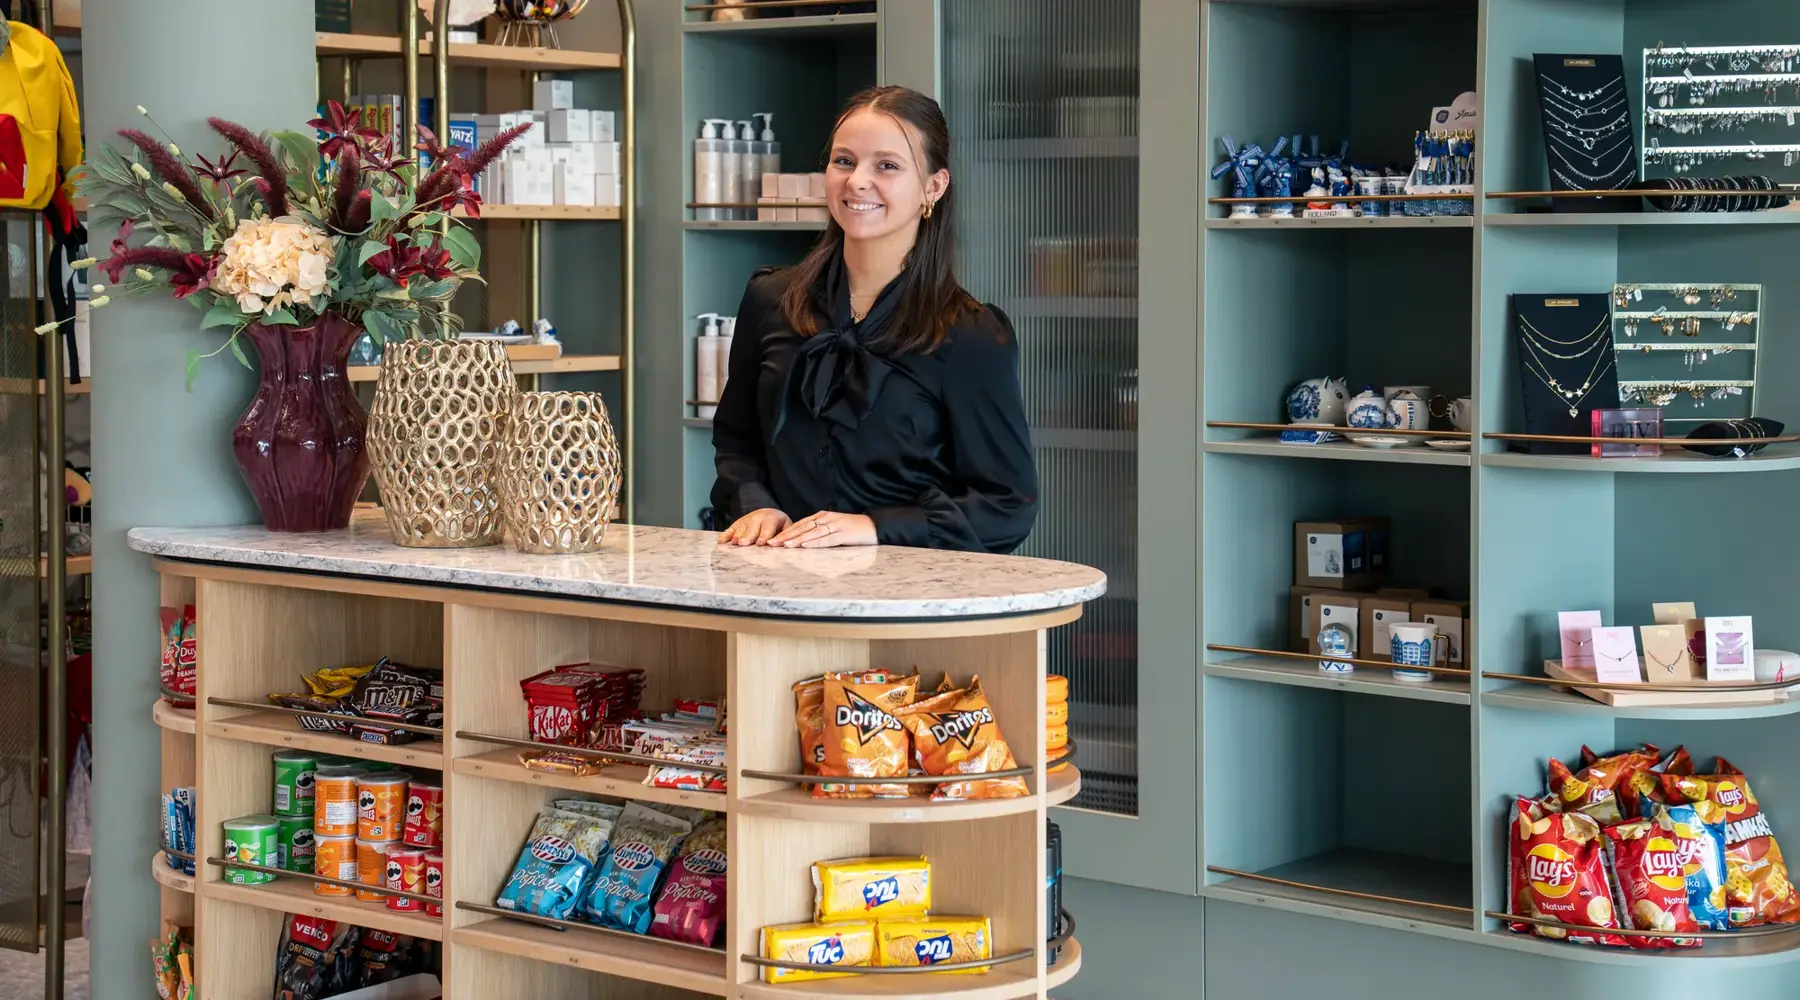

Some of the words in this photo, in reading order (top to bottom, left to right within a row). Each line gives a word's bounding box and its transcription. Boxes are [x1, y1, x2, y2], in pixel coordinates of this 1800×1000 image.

[181, 647, 196, 660] Duy
[177, 669, 197, 677] PEANU
[538, 706, 572, 738] KitKat
[836, 706, 903, 731] Doritos
[930, 708, 993, 744] Doritos
[641, 739, 664, 754] bue
[1719, 788, 1743, 806] Lay's
[1725, 811, 1774, 844] AMKA'S
[1530, 856, 1575, 887] Lay's
[866, 881, 898, 902] TUC
[1663, 896, 1689, 905] Natur
[1542, 902, 1576, 911] Naturel
[295, 922, 329, 942] VENCO
[810, 943, 841, 964] TUC
[919, 940, 951, 960] TUC
